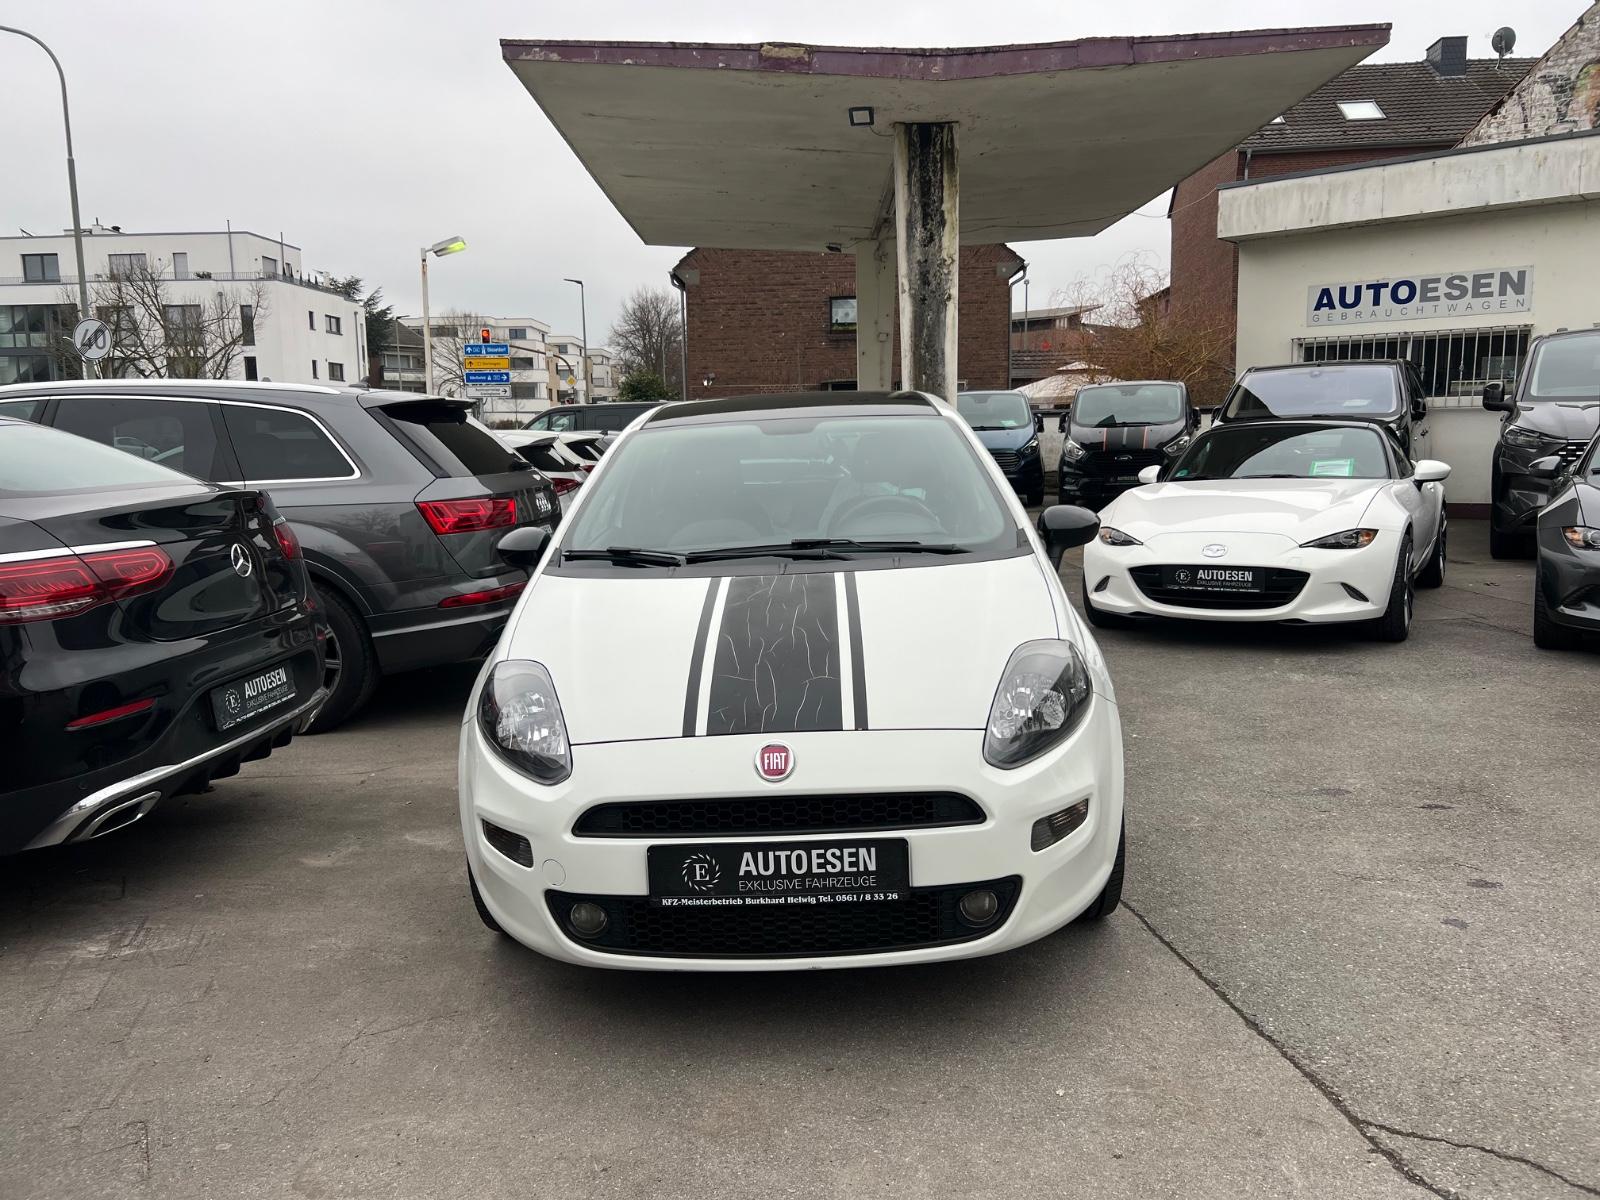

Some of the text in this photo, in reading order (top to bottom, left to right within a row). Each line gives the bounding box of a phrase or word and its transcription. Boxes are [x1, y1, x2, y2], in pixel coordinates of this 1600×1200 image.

[1313, 270, 1527, 312] AUTOESEN
[1312, 298, 1526, 323] GEBRAUCHTWAGEN
[1197, 569, 1253, 582] AUTOESEN
[244, 667, 286, 699] AUTOESEN
[764, 752, 787, 770] FIAT
[738, 847, 877, 876] AUTOESEN
[693, 863, 710, 881] E
[738, 875, 877, 892] EXKLUSIVE FAHRZEUGE
[662, 898, 743, 906] KFZ-Meisterbetrieb
[745, 897, 785, 905] Burkhard
[787, 896, 816, 905] Helwig
[836, 894, 857, 902] 0561
[886, 892, 899, 900] 26
